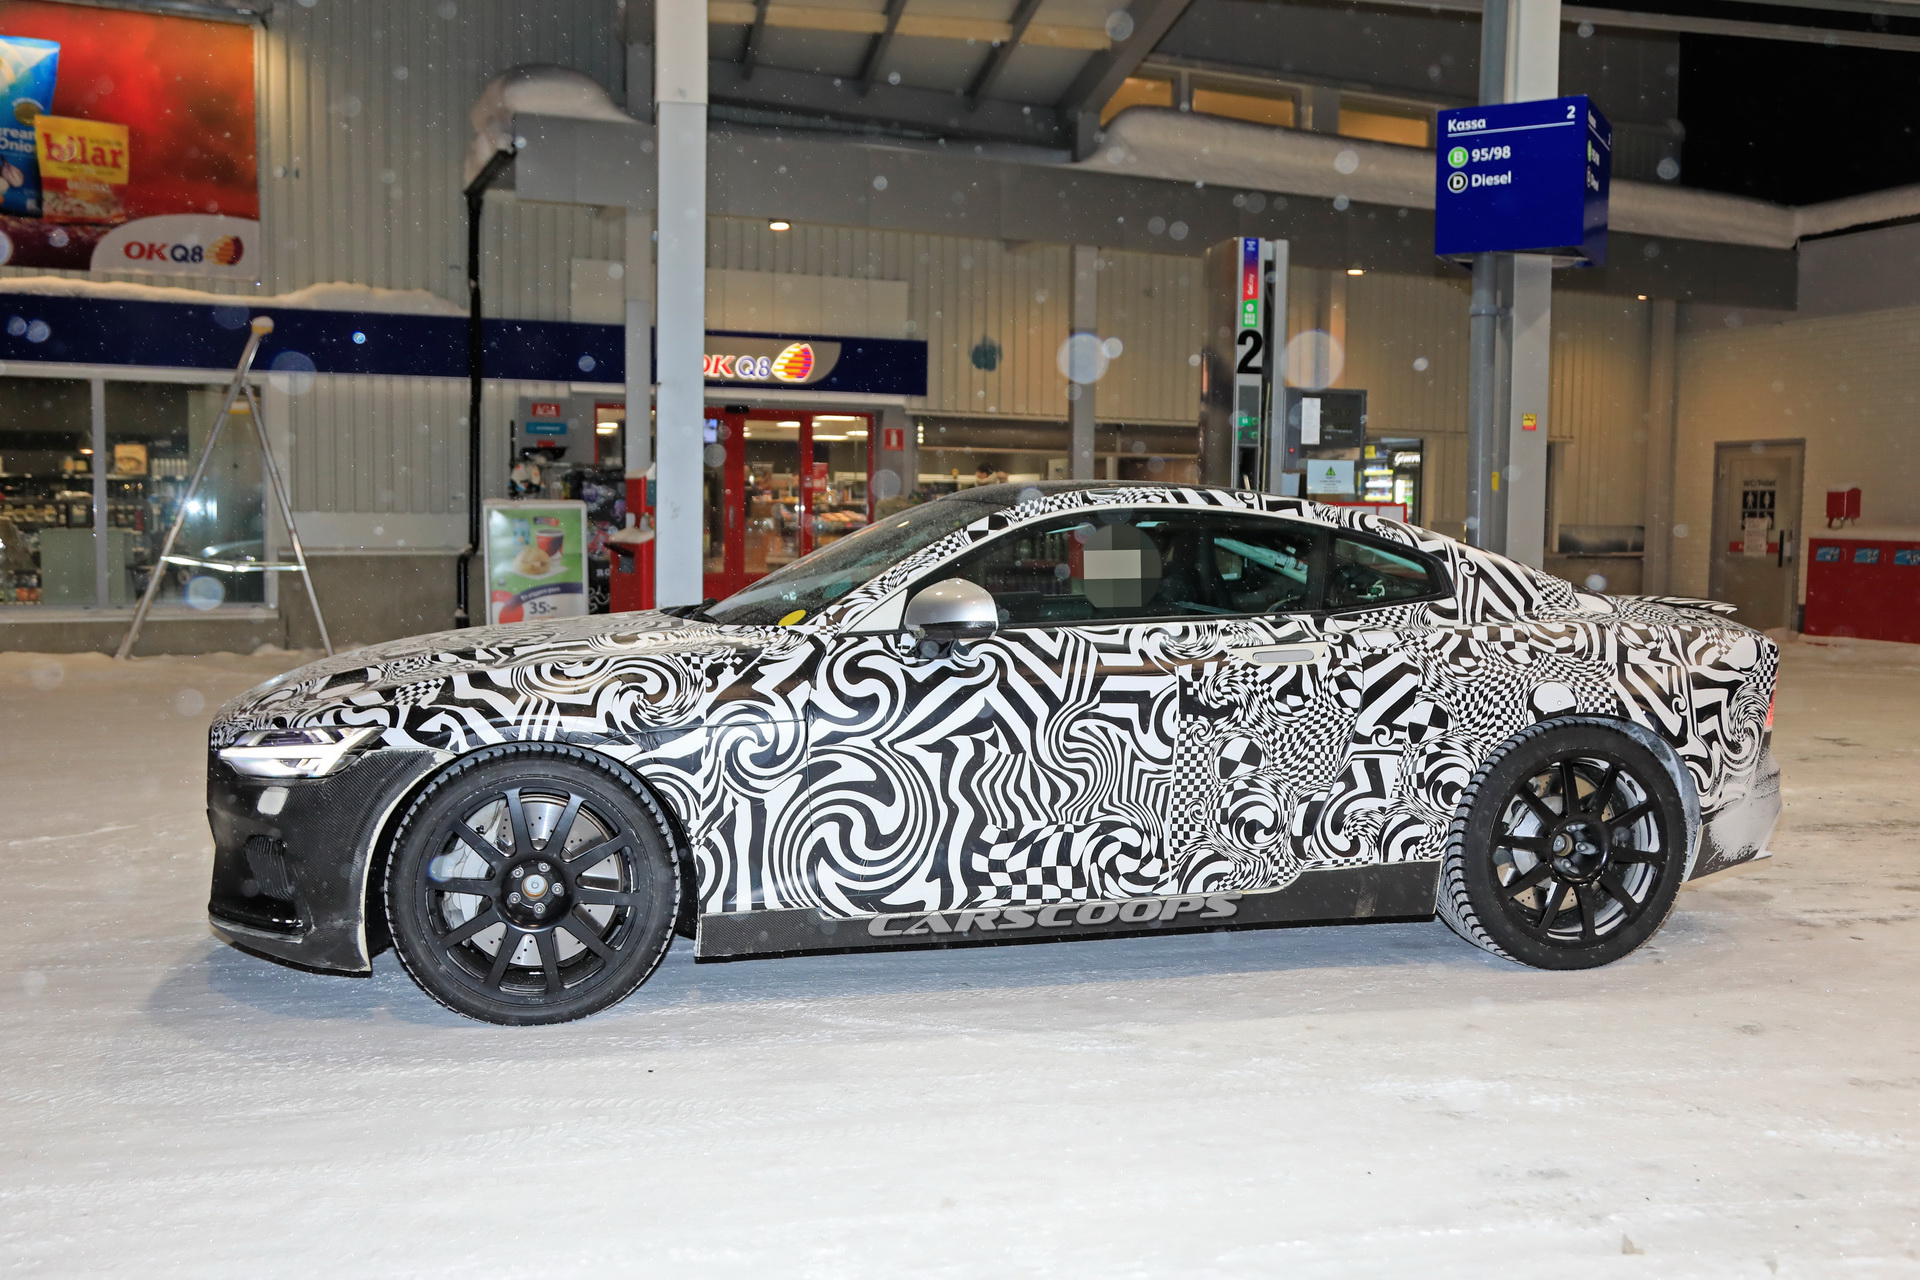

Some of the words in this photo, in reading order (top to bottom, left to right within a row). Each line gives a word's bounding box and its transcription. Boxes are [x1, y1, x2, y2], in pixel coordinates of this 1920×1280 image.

[1448, 118, 1486, 132] Kassa
[1566, 105, 1576, 119] 2
[0, 136, 35, 153] Onio
[42, 131, 124, 168] bilar
[1453, 151, 1464, 163] B
[1471, 145, 1511, 162] 95/98
[1452, 176, 1464, 189] D
[1471, 170, 1512, 187] Diesel
[124, 241, 203, 263] OKQ8
[1237, 329, 1263, 374] 2
